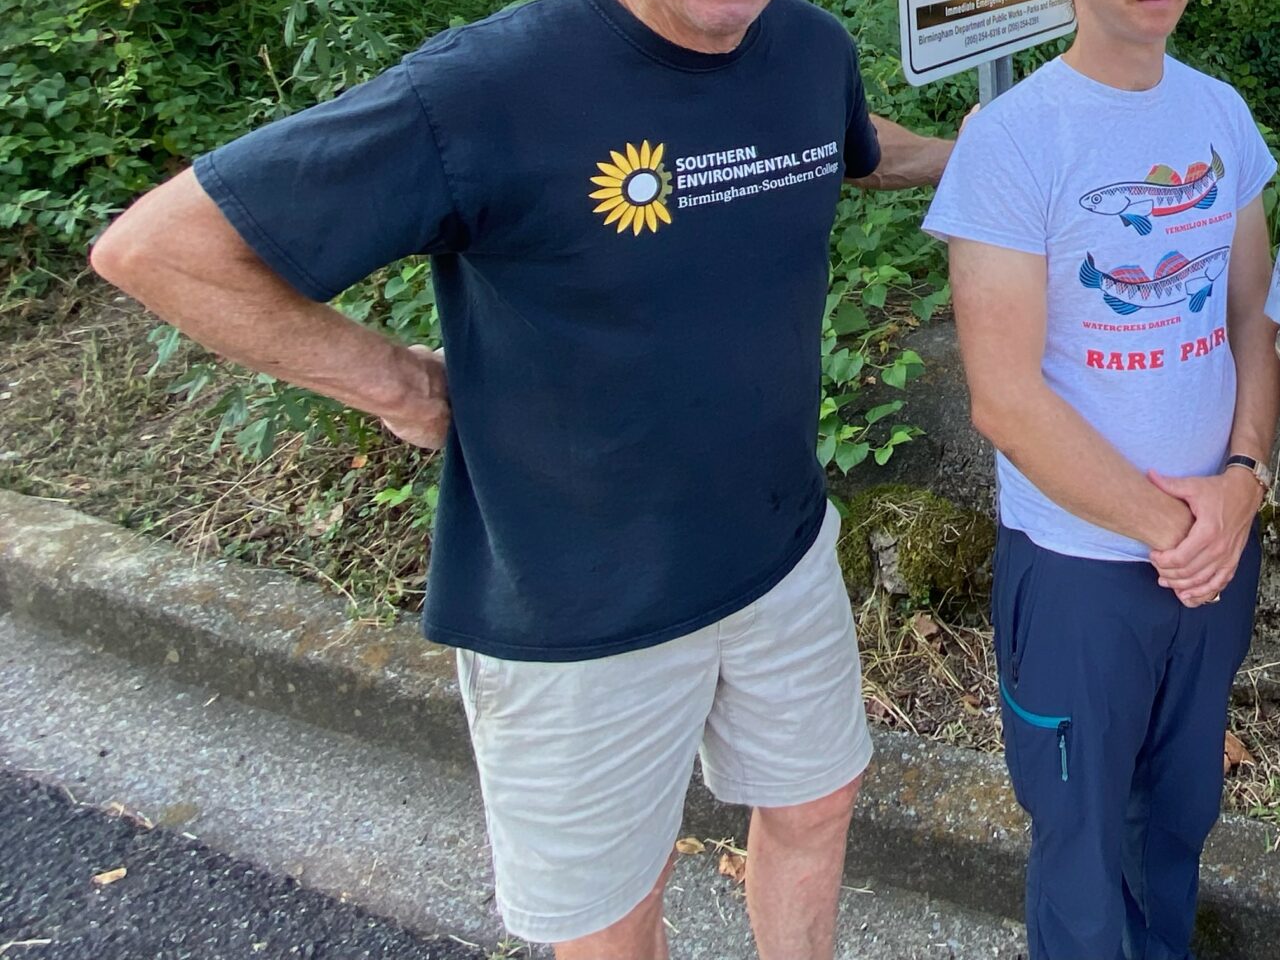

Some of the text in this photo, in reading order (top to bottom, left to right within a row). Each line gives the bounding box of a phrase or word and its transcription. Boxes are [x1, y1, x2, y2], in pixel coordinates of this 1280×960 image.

[945, 1, 975, 17] Immediate
[918, 28, 953, 45] Birmingham
[955, 19, 985, 35] Department
[986, 16, 991, 26] of
[992, 12, 1007, 24] Public
[1008, 8, 1022, 19] Works
[1027, 4, 1039, 14] Parks
[1040, 2, 1048, 11] and
[675, 145, 757, 172] SOUTHERN
[677, 141, 838, 190] ENVIRONMENTAL CENTER
[678, 171, 814, 208] Birmingham-Southern
[1165, 219, 1207, 234] VERMILION
[1082, 316, 1181, 332] WATERCRESS DARTER
[1087, 349, 1165, 371] RARE
